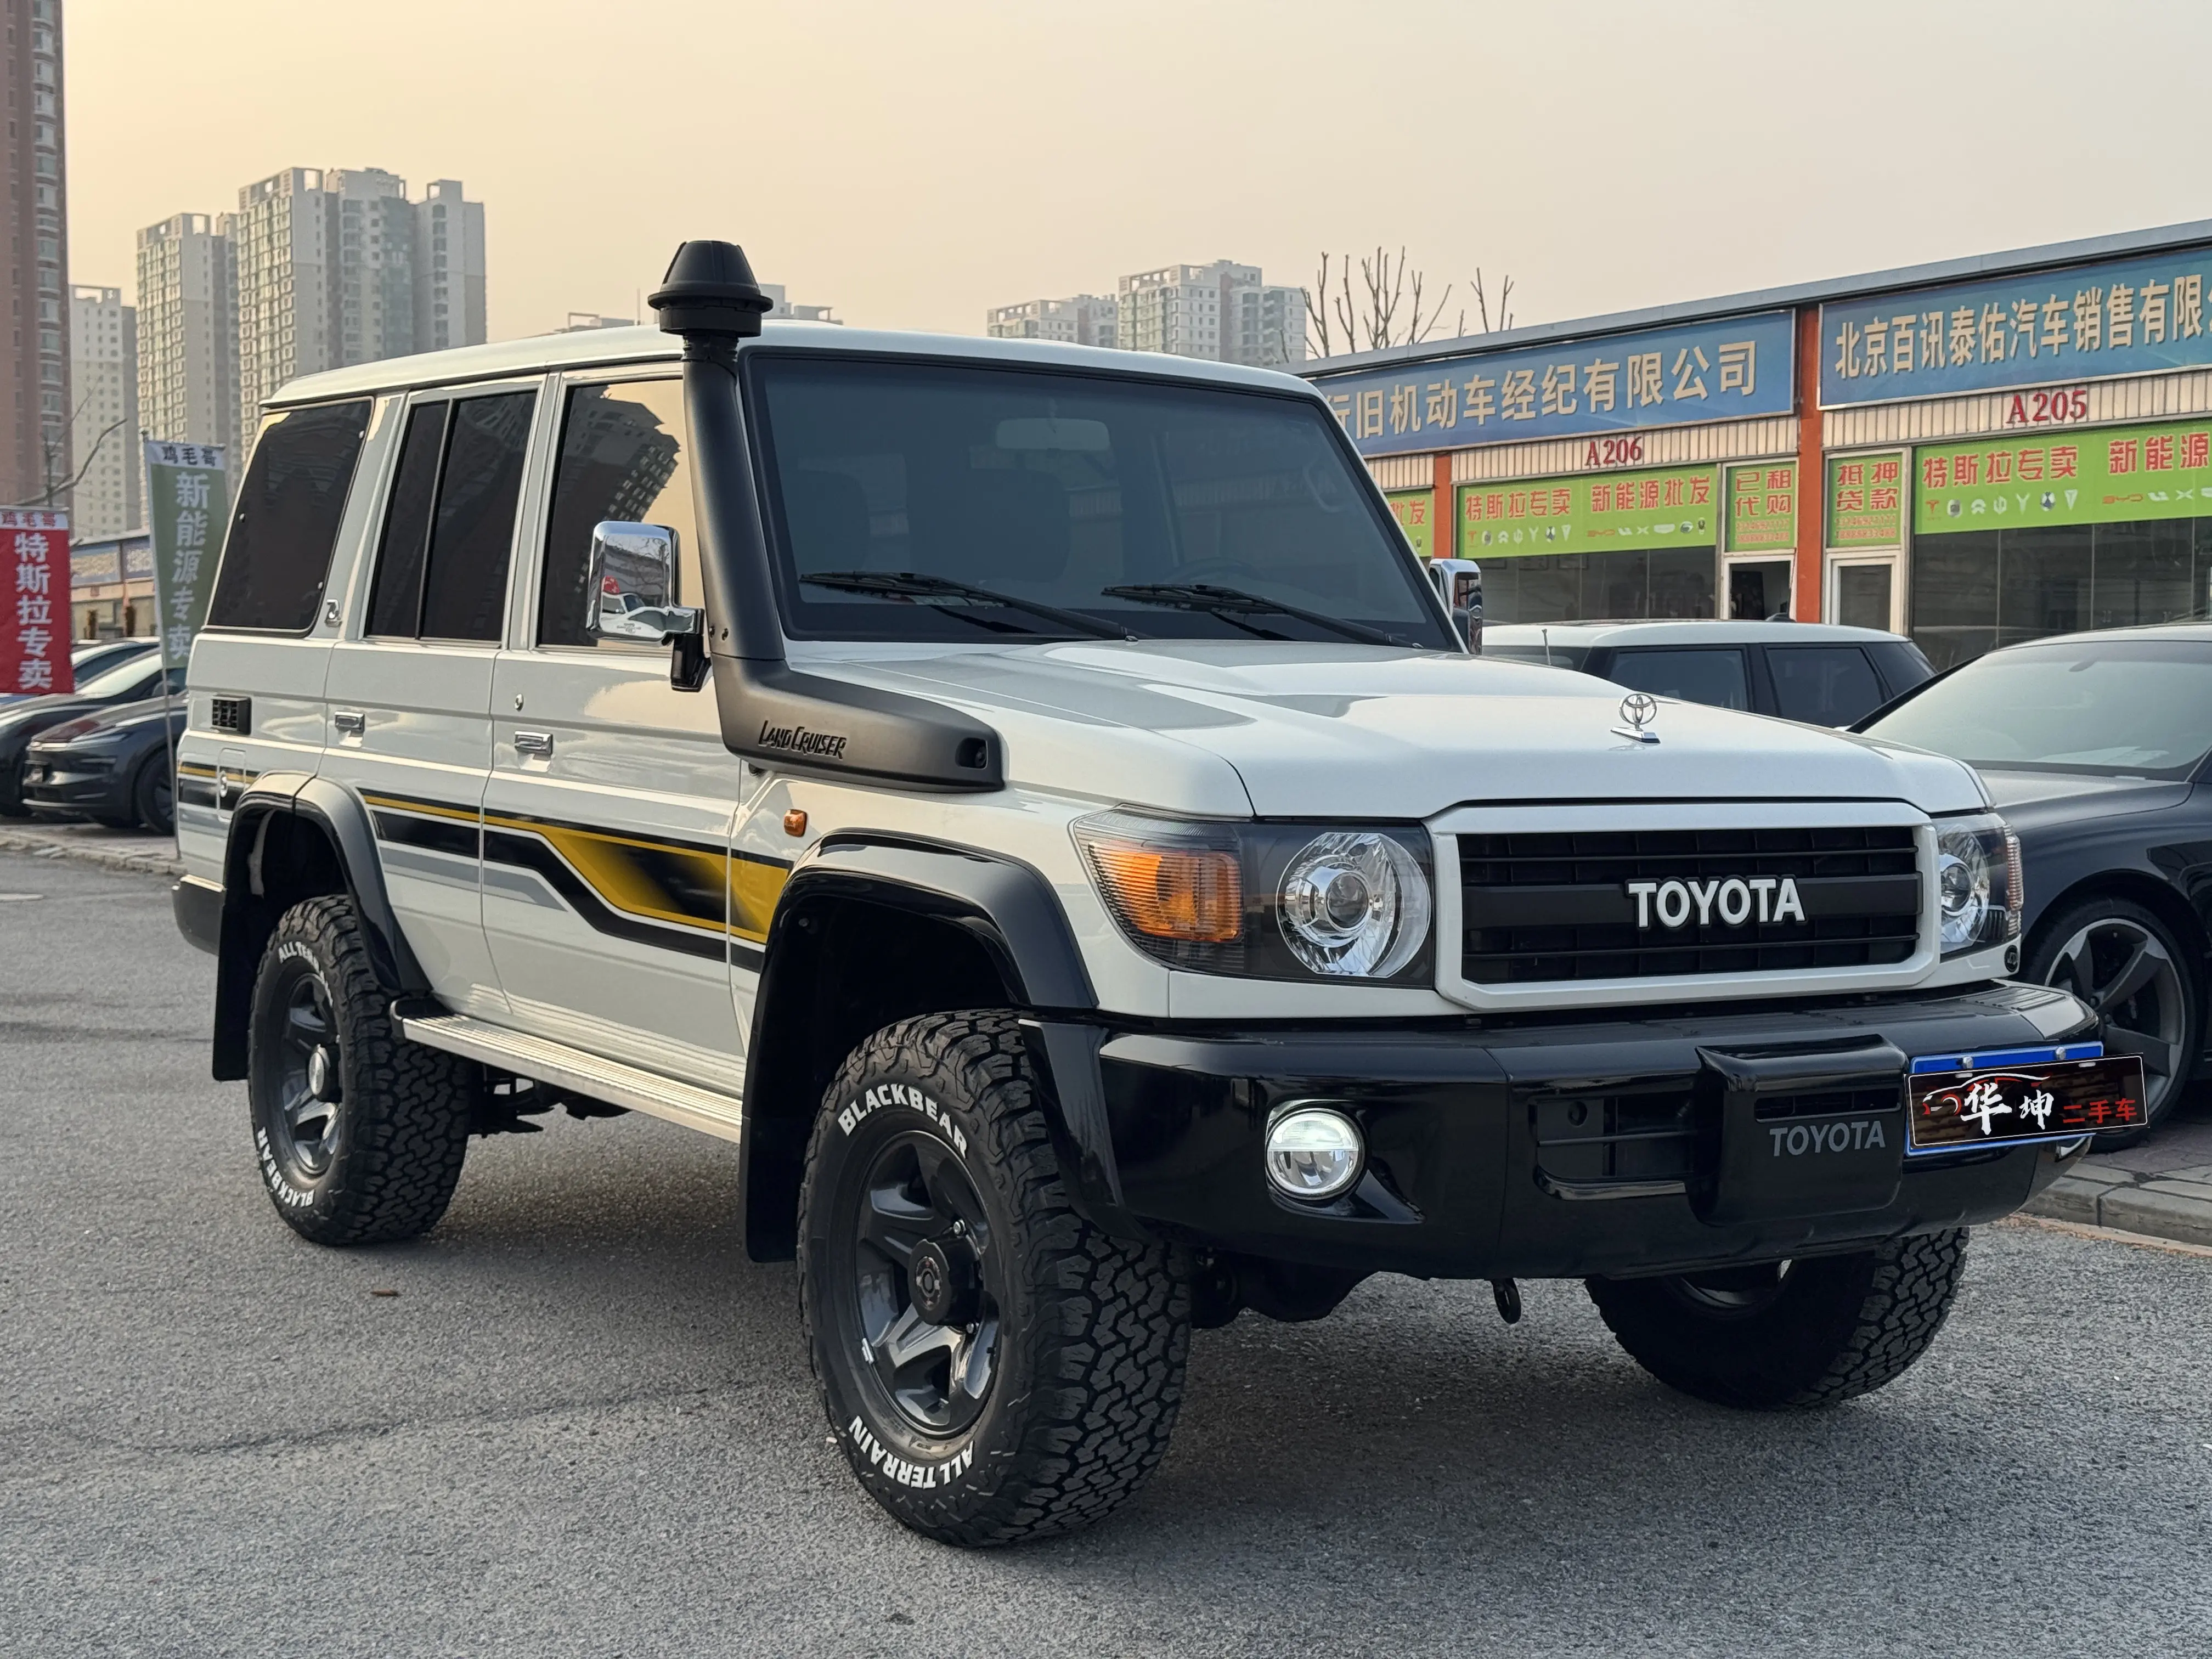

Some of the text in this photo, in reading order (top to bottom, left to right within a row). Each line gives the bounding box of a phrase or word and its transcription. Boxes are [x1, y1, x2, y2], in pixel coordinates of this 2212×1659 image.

[1835, 274, 2212, 380] 北京百讯泰佑汽车销售有限
[2006, 390, 2086, 424] A205
[1584, 436, 1642, 466] A206
[1923, 445, 2078, 490] 特斯拉专卖
[2109, 432, 2209, 475] 新能源
[1592, 475, 1710, 512] 新能源批发
[1838, 462, 1898, 486] 抵押
[1466, 488, 1571, 521] 特斯拉专卖
[1735, 494, 1791, 516] 代购
[1837, 488, 1898, 512] 贷款
[168, 471, 211, 661] 新能源专卖
[14, 532, 53, 690] 特斯拉专卖
[758, 720, 847, 760] LAND CRUISER
[1628, 878, 1805, 928] TOYOTA
[837, 1083, 968, 1159] BLACKBEAR
[1769, 1120, 1886, 1157] TOYOTA
[848, 1415, 974, 1489] ALL TERRAIN
